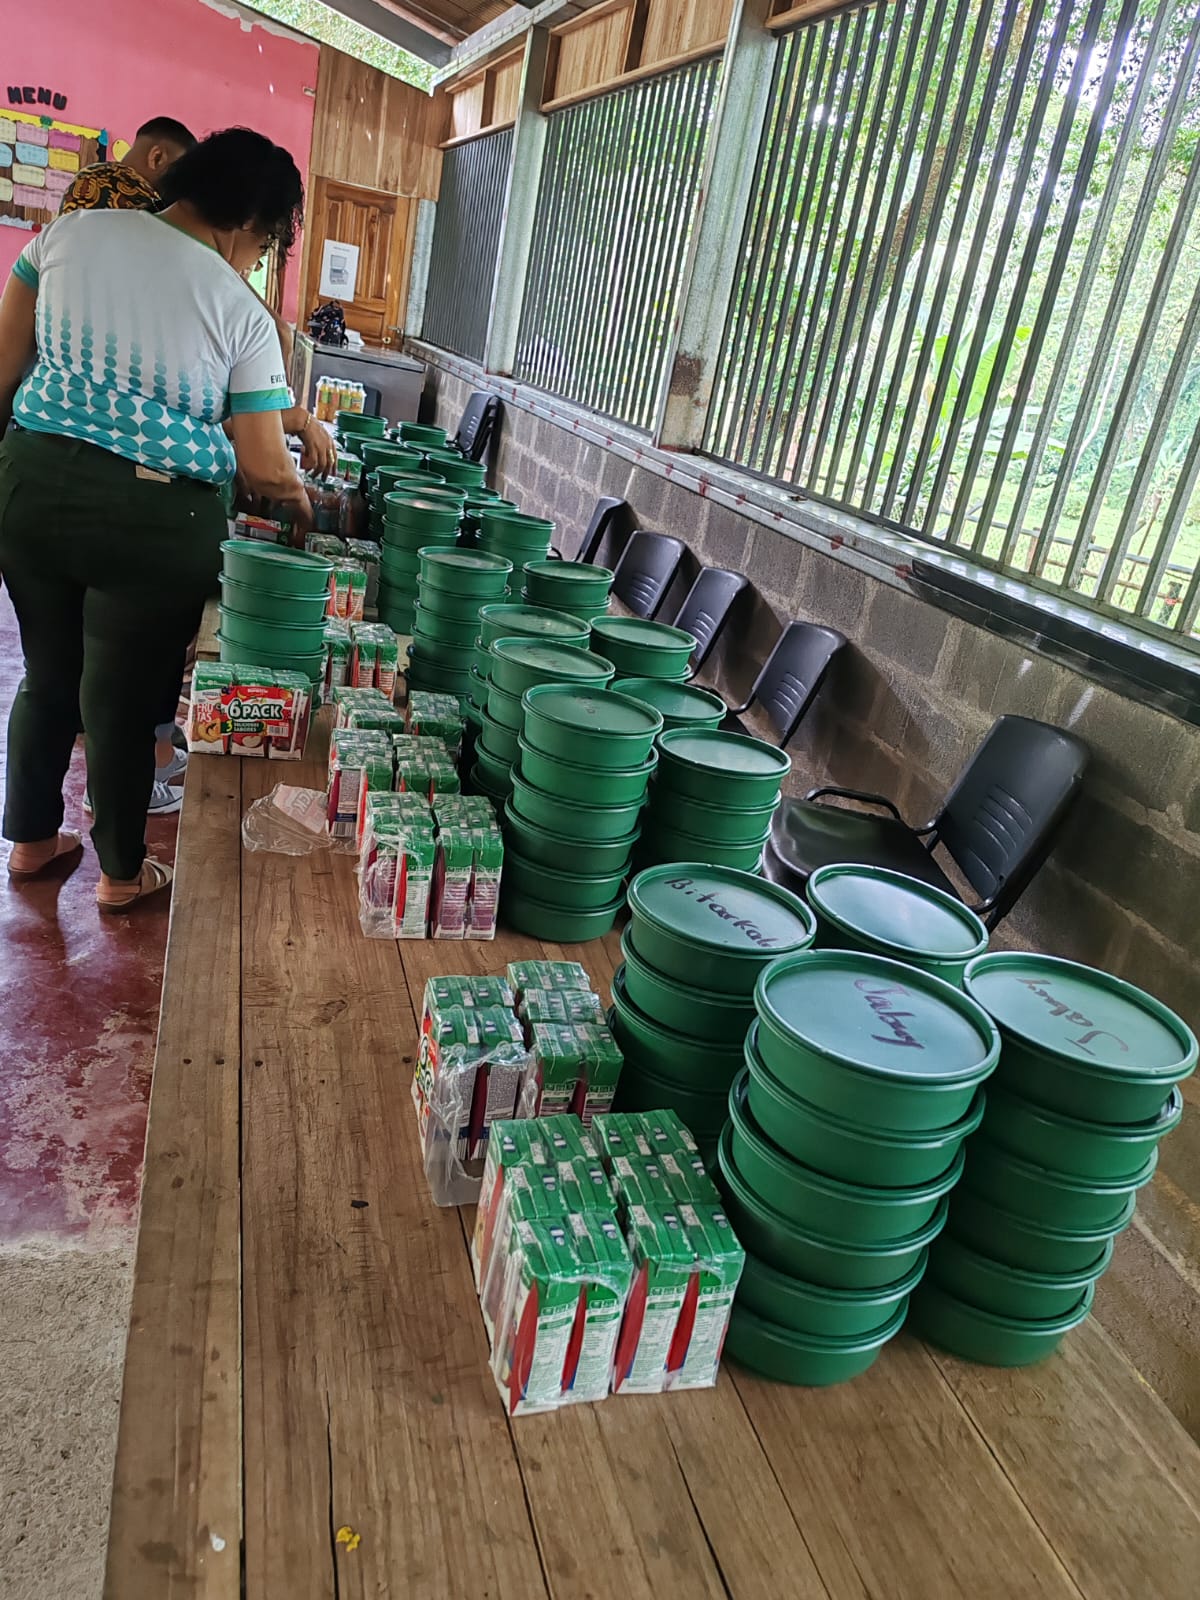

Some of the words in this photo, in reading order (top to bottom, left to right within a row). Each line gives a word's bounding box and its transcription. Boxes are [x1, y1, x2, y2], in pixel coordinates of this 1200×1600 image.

[7, 86, 67, 110] MENU
[230, 700, 241, 718] 6
[243, 705, 281, 719] PACK
[226, 720, 233, 733] 3
